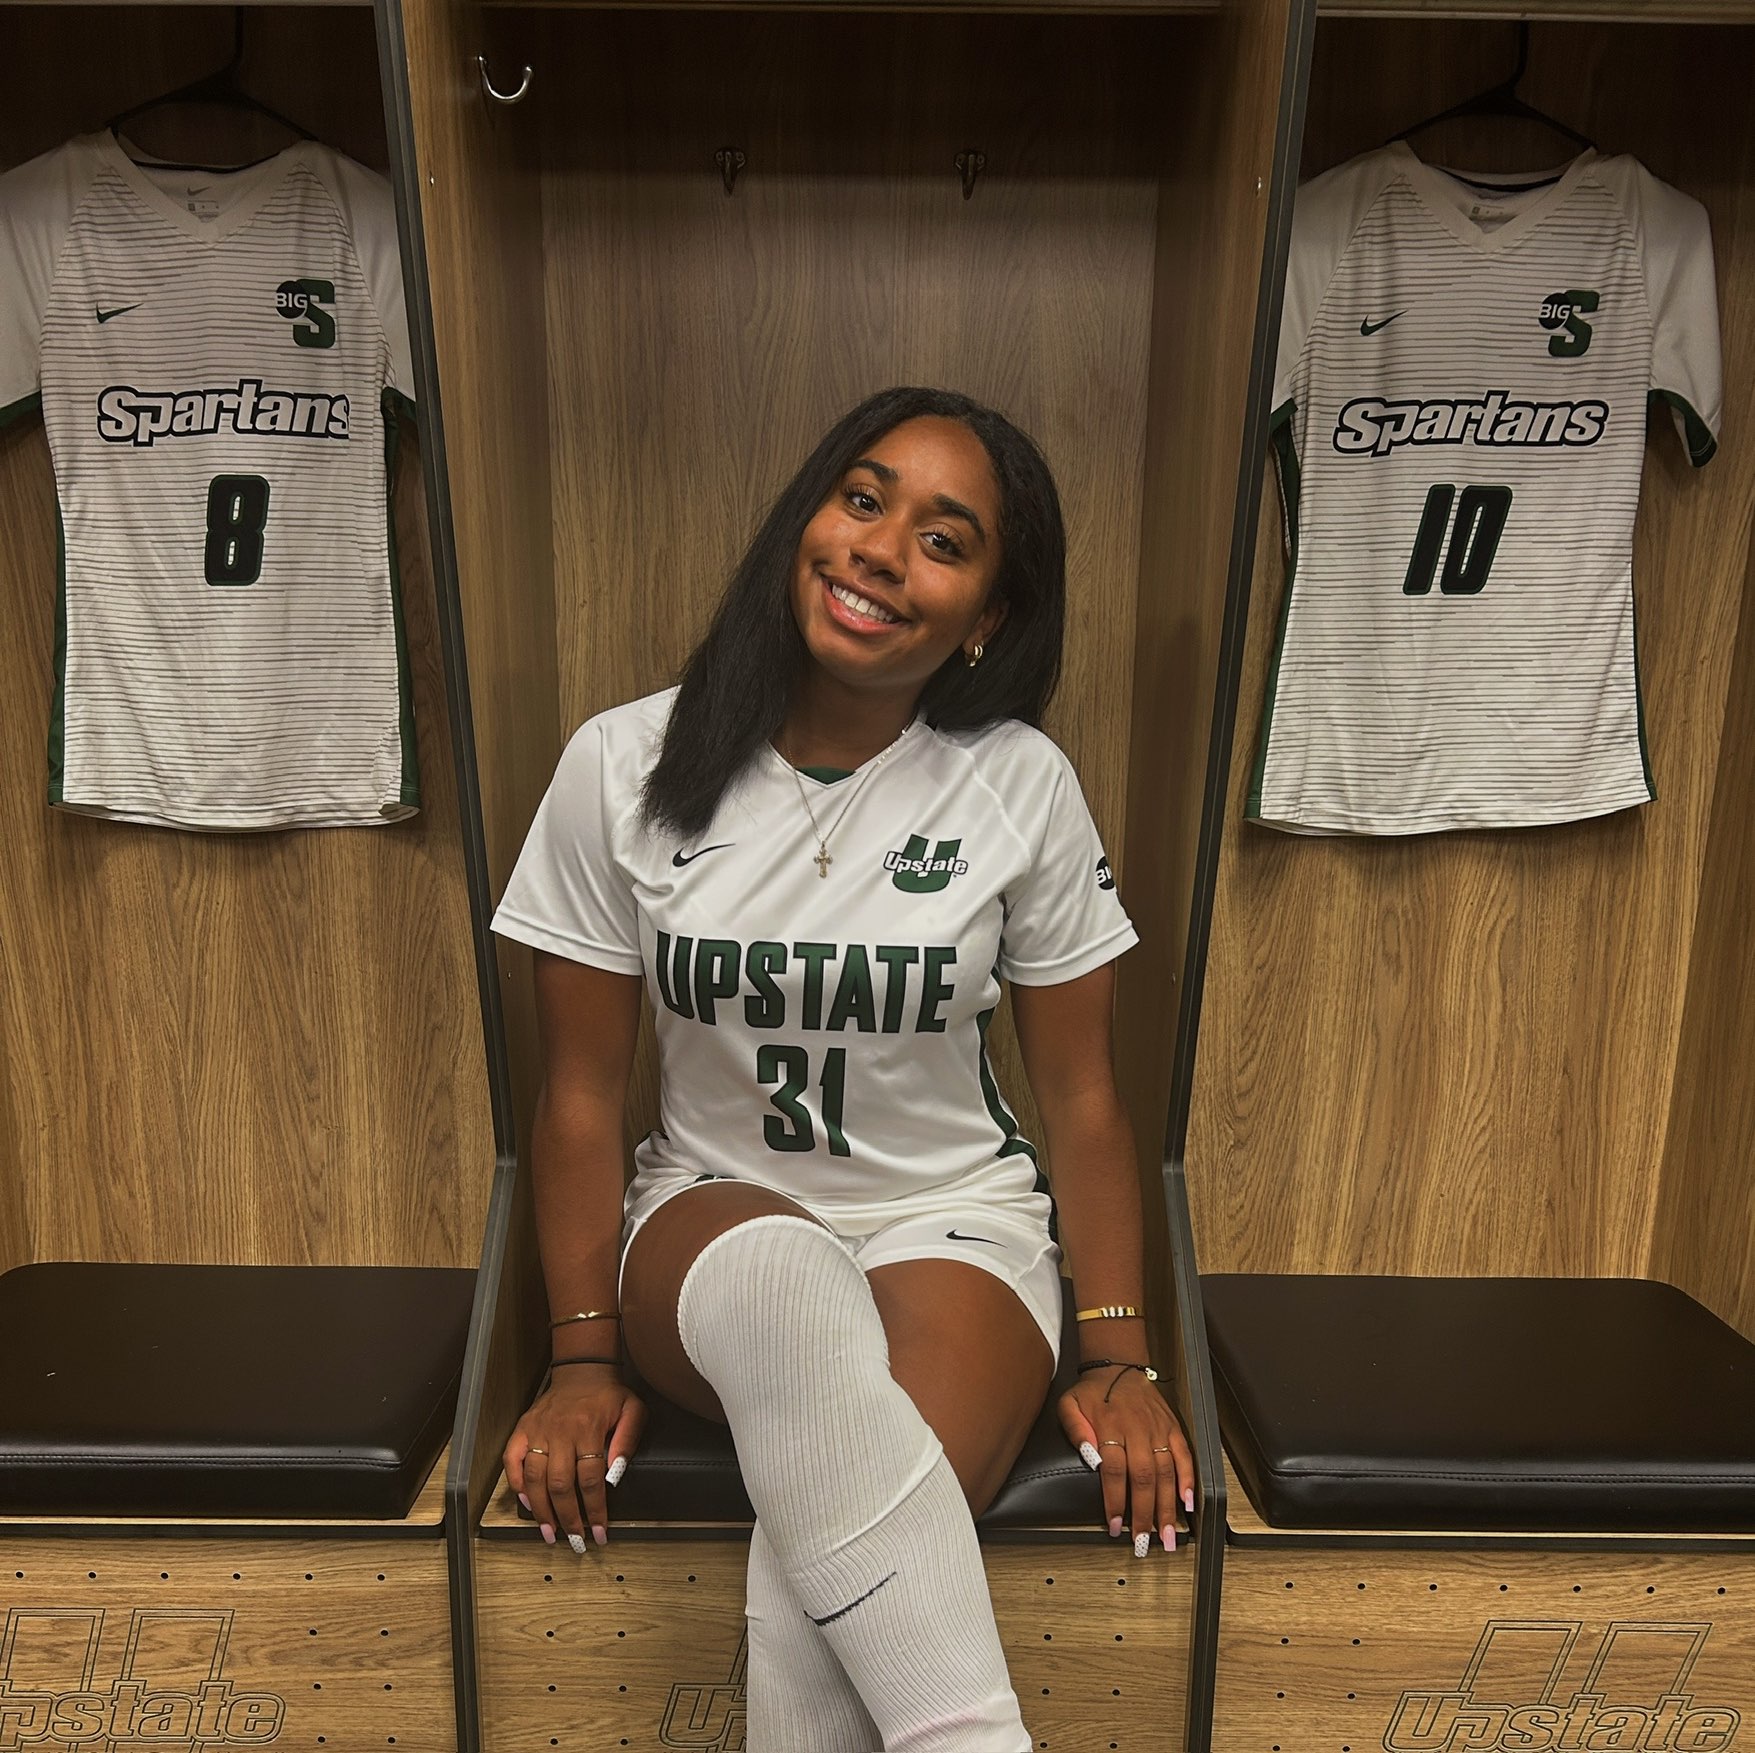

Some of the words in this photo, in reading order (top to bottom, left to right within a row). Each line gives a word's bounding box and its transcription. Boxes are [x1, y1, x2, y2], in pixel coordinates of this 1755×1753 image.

[275, 292, 308, 309] BIG
[1540, 303, 1571, 319] BIG
[97, 379, 351, 447] Spartans
[1333, 389, 1610, 458] Spartans
[204, 474, 271, 587] 8
[1402, 484, 1514, 596] 10
[883, 851, 968, 875] Upstate
[1096, 865, 1112, 885] BI
[656, 929, 958, 1034] UPSTATE
[756, 1044, 852, 1158] 31
[0, 1679, 286, 1753] pstate
[1382, 1691, 1741, 1753] Upstate
